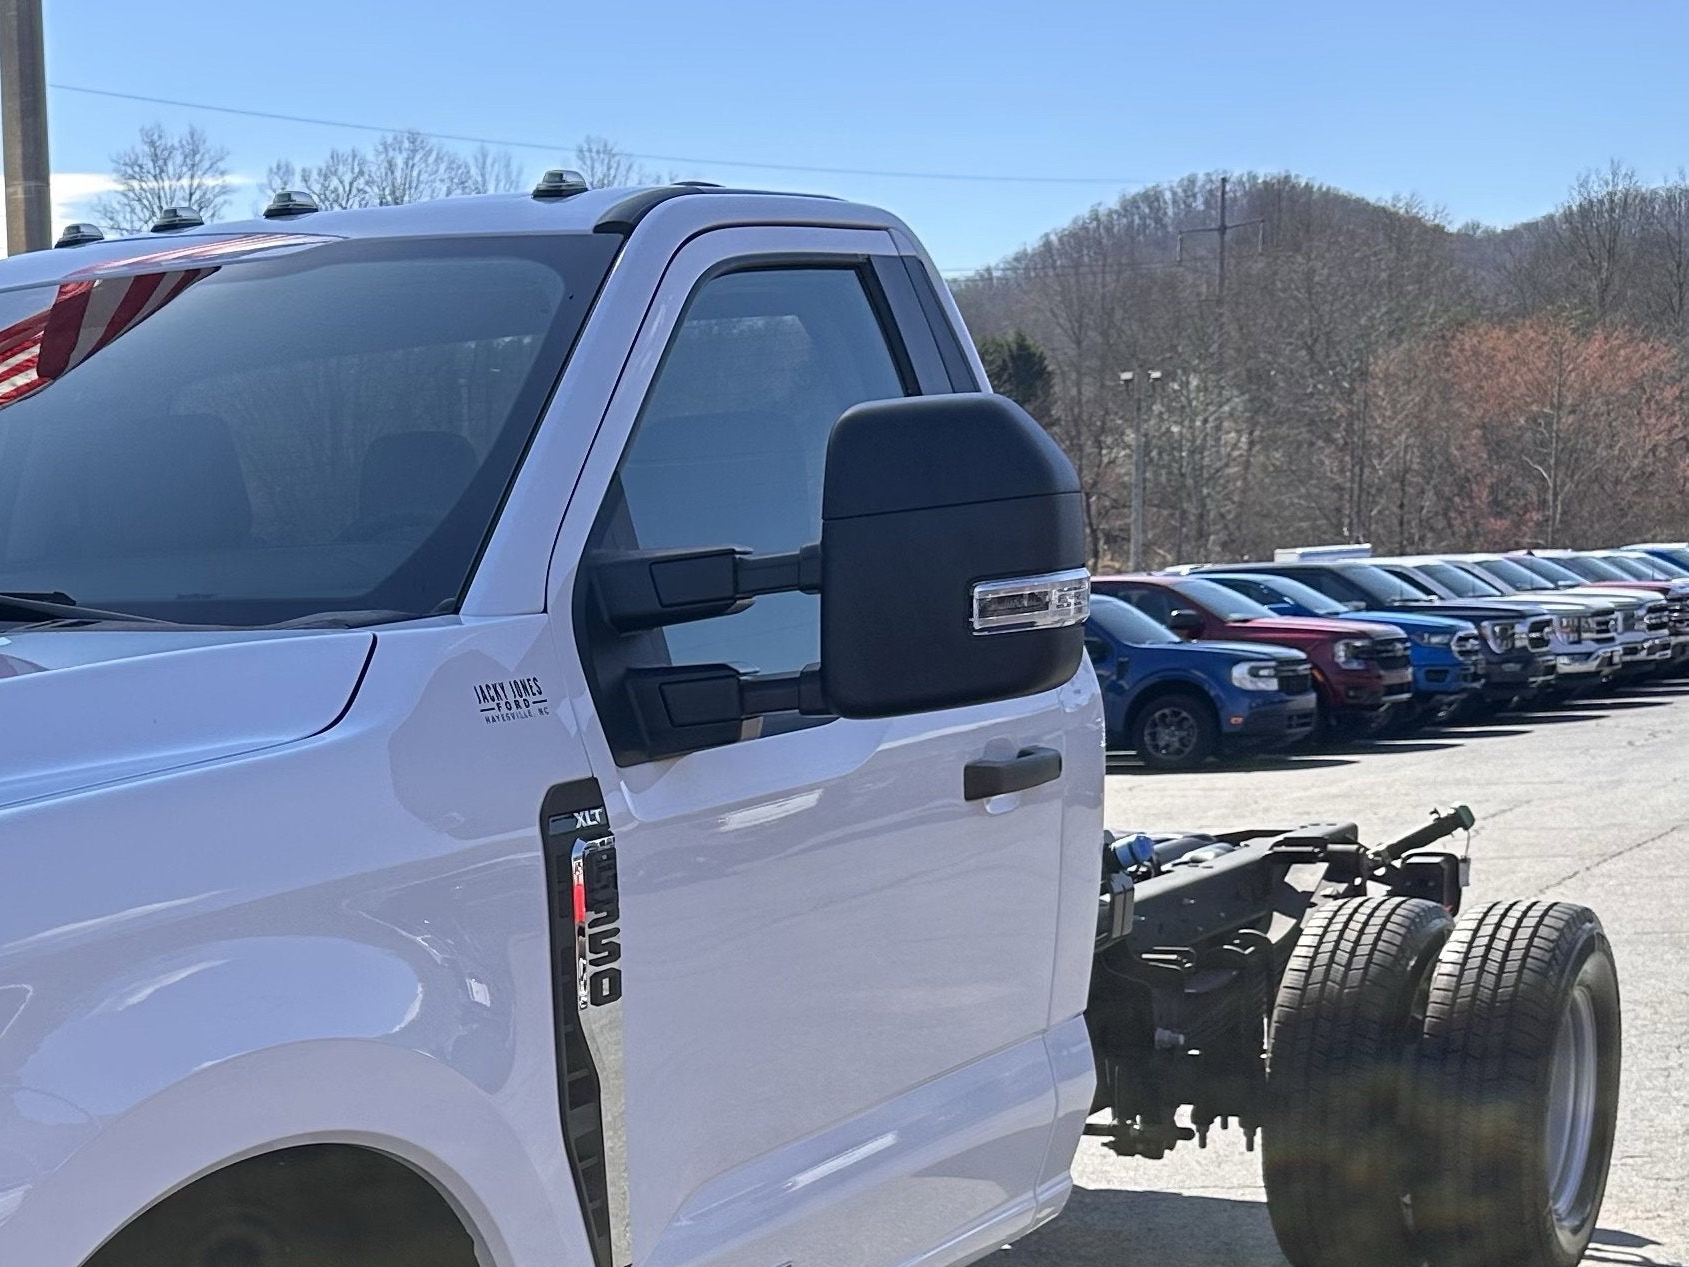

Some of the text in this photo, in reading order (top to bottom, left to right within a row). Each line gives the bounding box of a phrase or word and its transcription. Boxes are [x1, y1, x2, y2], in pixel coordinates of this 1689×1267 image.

[473, 676, 543, 704] JACKY JONES
[496, 698, 531, 713] FORD
[572, 807, 604, 829] XLT
